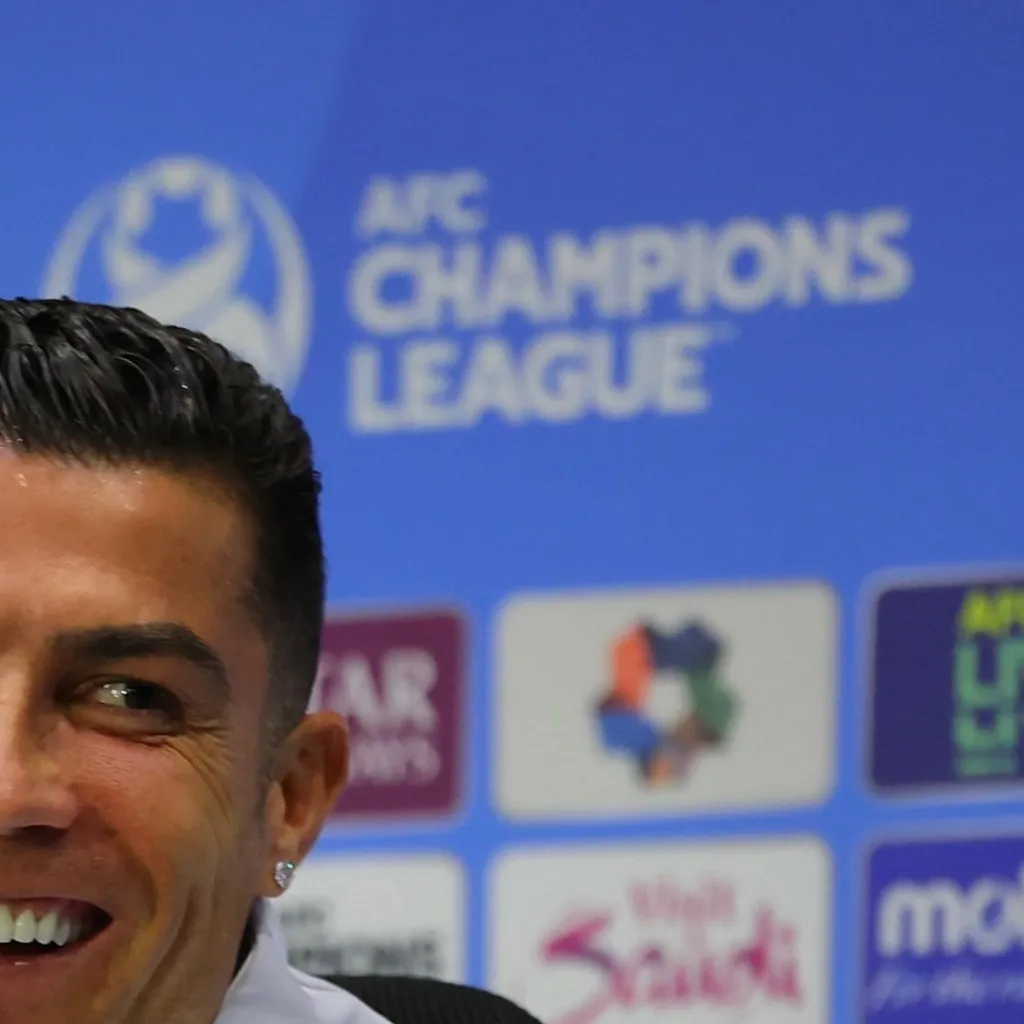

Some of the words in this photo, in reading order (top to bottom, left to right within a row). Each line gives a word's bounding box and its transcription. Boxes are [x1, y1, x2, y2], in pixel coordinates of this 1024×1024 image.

[358, 171, 487, 236] AFC
[349, 208, 913, 334] CHAMPIONS
[349, 322, 712, 433] LEAGUE
